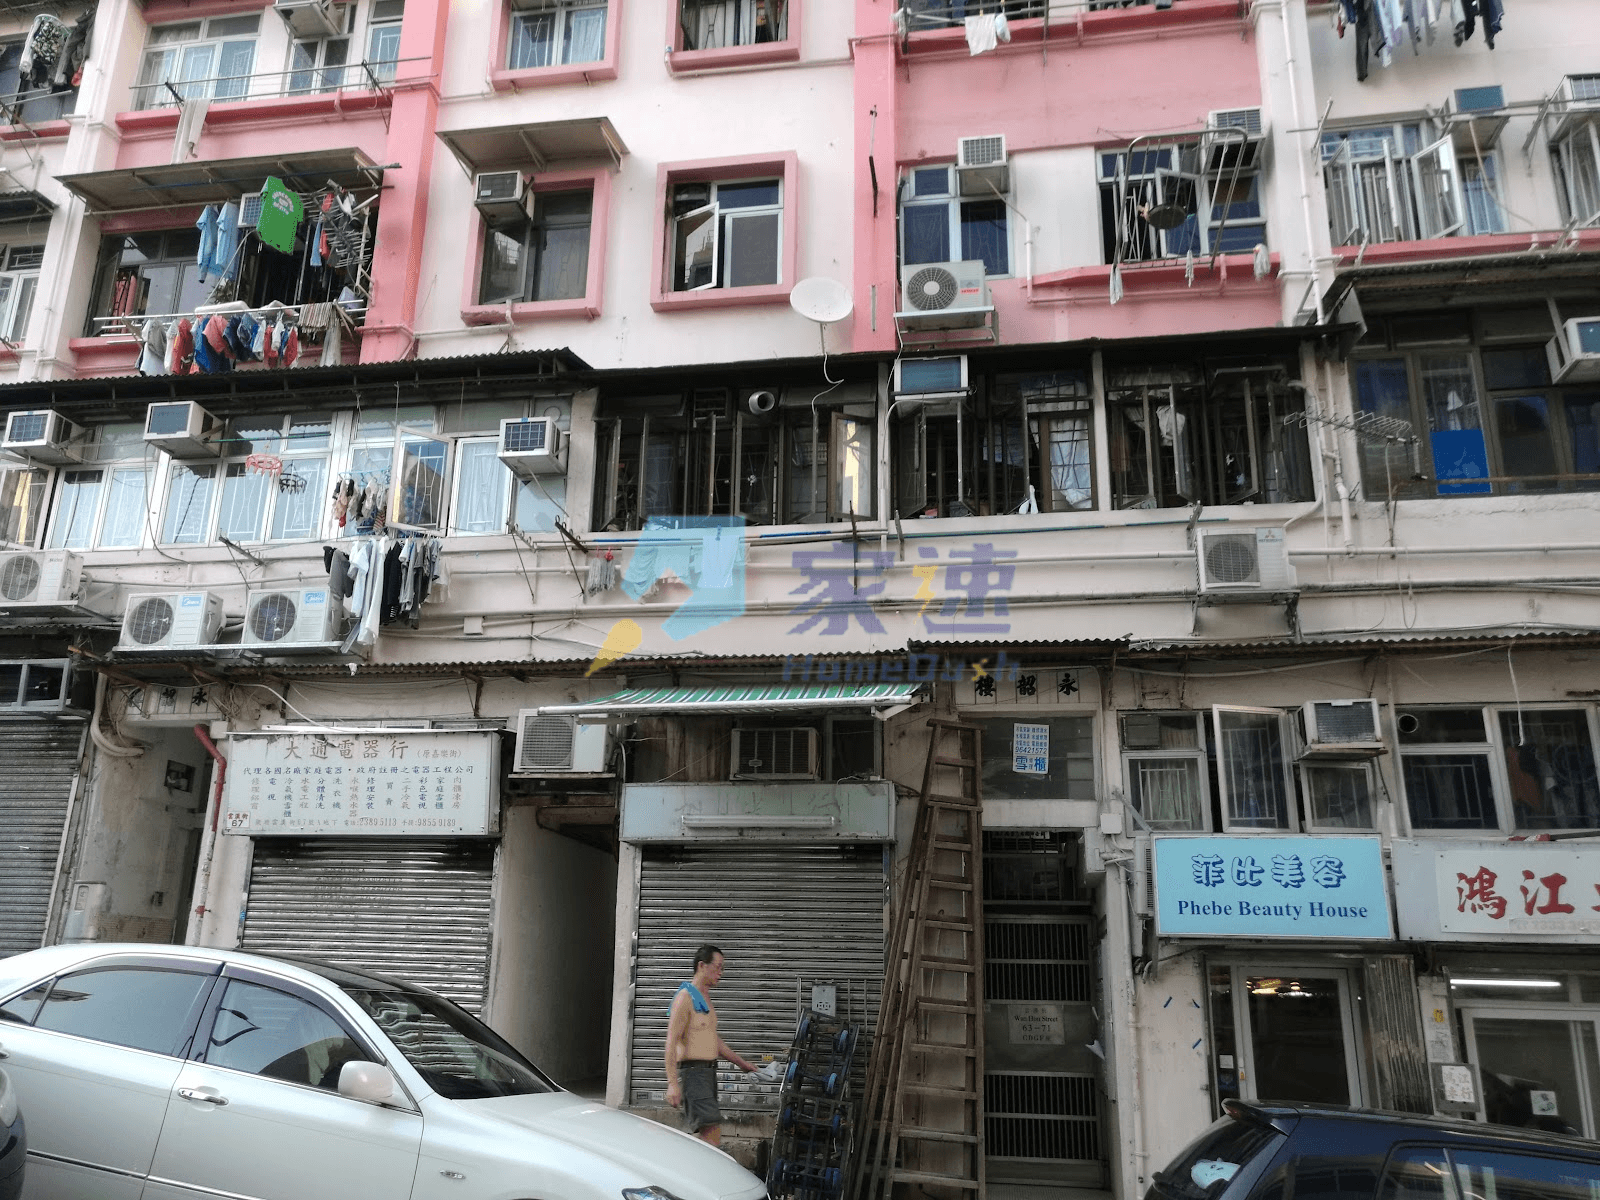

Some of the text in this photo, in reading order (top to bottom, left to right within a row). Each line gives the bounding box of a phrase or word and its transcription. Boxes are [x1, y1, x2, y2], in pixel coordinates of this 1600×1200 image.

[283, 738, 409, 760] 大通電器行
[332, 777, 343, 809] 洗衣機
[365, 777, 376, 810] 修理安裝
[418, 777, 428, 810] 彩色電視
[232, 819, 244, 827] 67
[1191, 854, 1346, 888] 菲比美容
[1456, 866, 1600, 920] 鴻江
[1177, 900, 1369, 920] Phebe Beauty House
